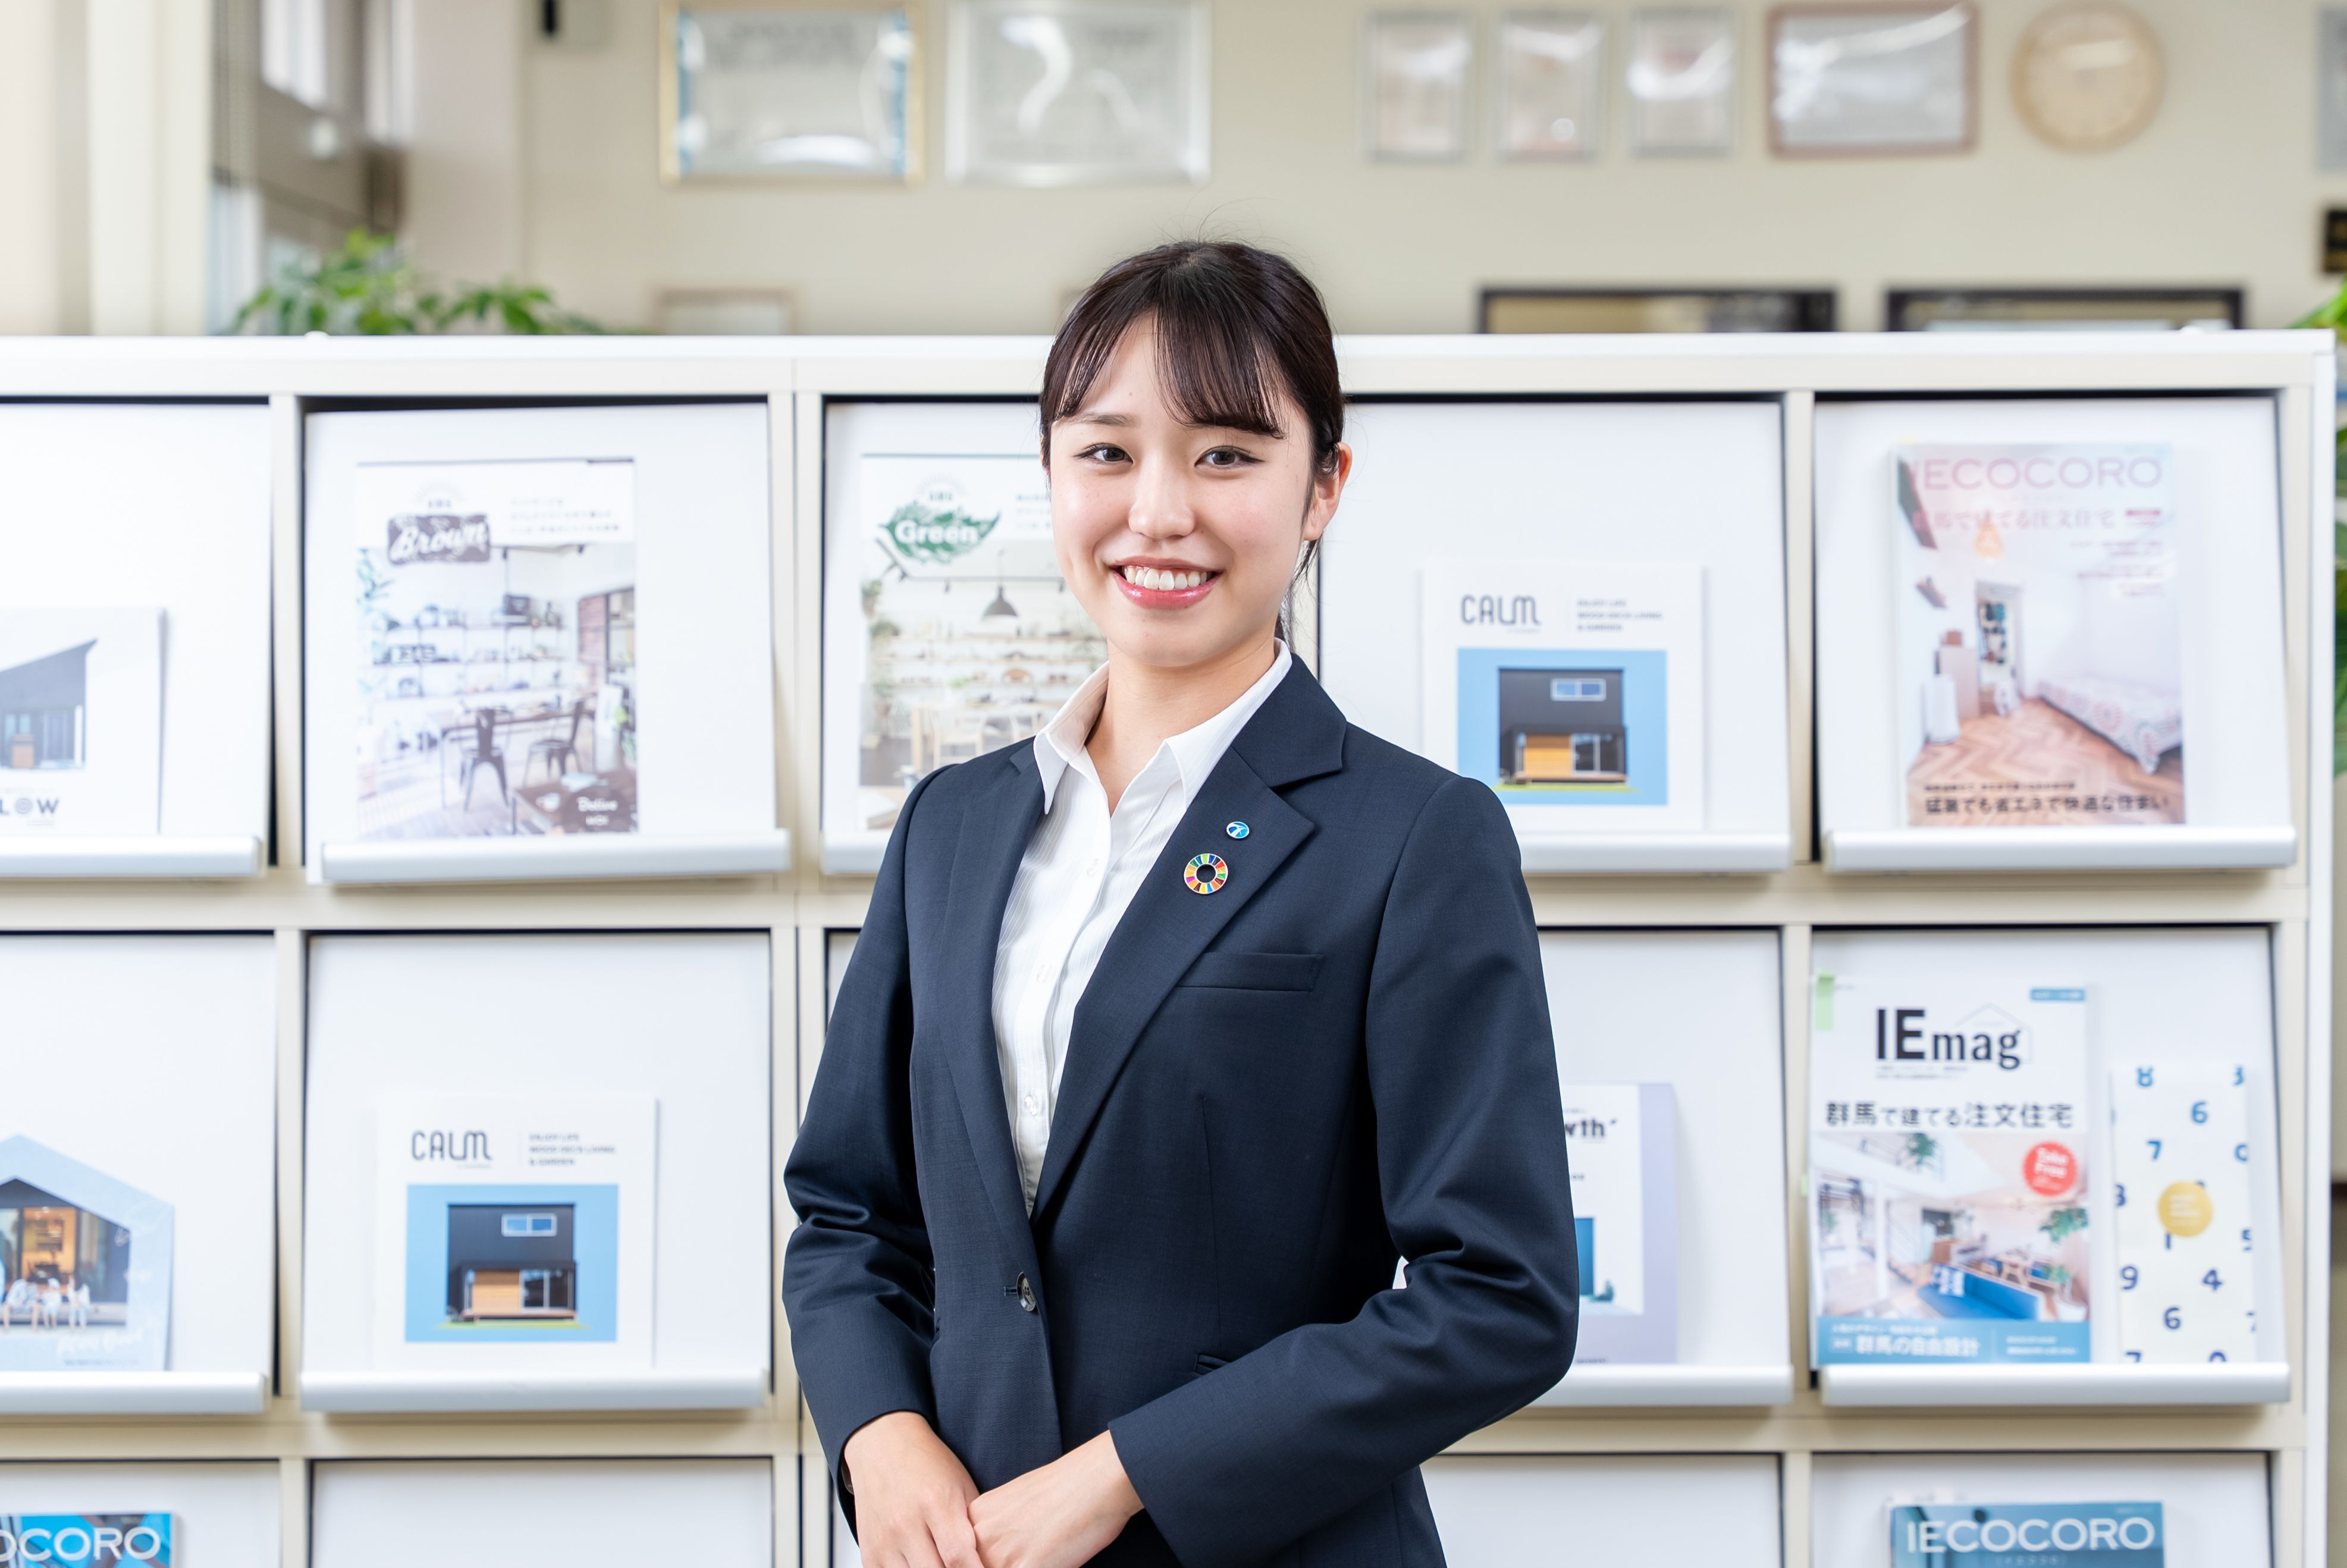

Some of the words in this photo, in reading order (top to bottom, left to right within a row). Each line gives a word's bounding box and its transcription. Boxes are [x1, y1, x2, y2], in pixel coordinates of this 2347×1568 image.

[390, 521, 487, 561] Brown
[894, 520, 980, 546] Green
[1461, 595, 1541, 625] CALM
[1876, 1008, 2021, 1070] IEmag
[1826, 1102, 2073, 1129] 群馬で建てる注文住宅
[2191, 1101, 2208, 1124] 6
[412, 1130, 492, 1161] CALM
[2037, 1147, 2069, 1165] Take
[2147, 1140, 2161, 1160] 7
[2035, 1163, 2067, 1180] Free
[2120, 1266, 2138, 1290] 9
[2202, 1269, 2223, 1291] 4
[2164, 1307, 2181, 1330] 6
[1907, 1517, 2155, 1553] IECOCORO
